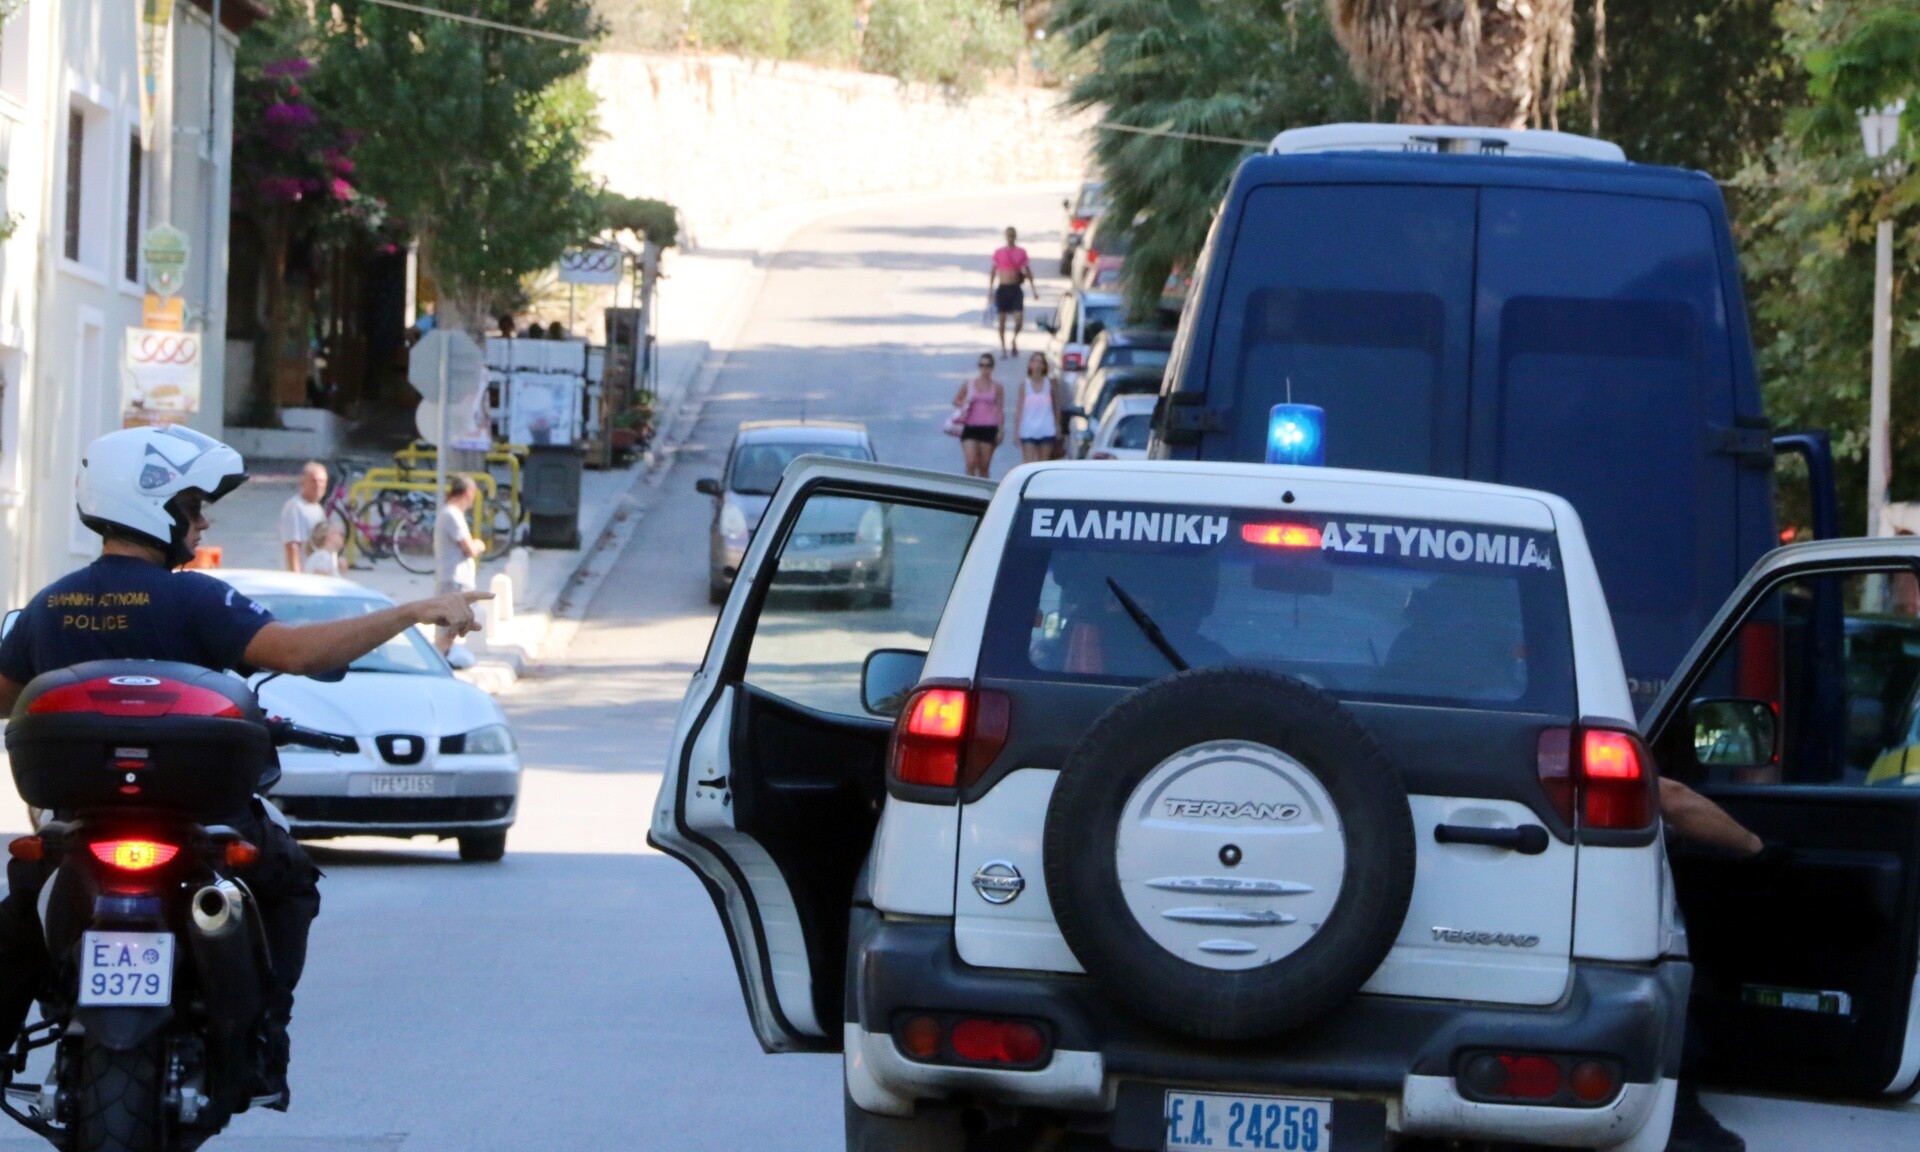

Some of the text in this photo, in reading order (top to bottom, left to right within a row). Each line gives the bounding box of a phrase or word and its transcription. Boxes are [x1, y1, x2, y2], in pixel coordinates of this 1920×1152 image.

[1030, 507, 1553, 571] ΕΛΛΗΝΙΚΗ ΑΣΤΥΝΟΜΙΑ
[63, 614, 128, 631] POLICE
[1164, 798, 1301, 821] TERRANO
[1432, 926, 1540, 948] TERRANO
[91, 972, 160, 996] 9379
[1228, 1102, 1319, 1152] 24259
